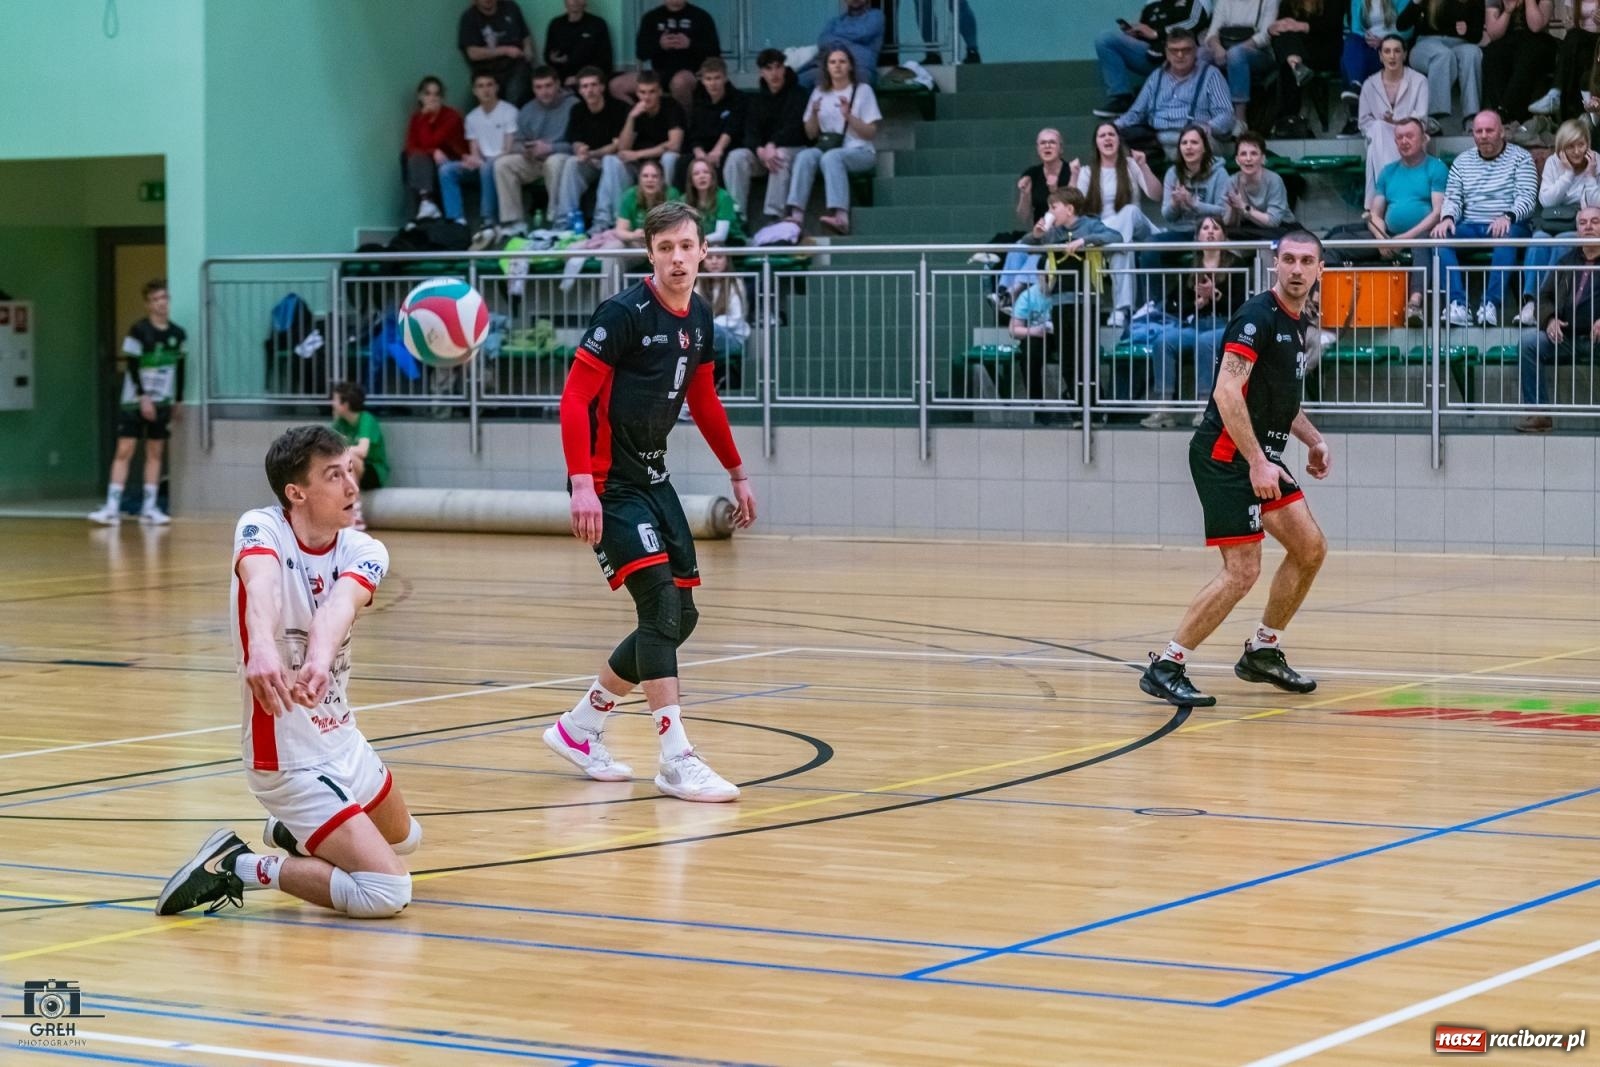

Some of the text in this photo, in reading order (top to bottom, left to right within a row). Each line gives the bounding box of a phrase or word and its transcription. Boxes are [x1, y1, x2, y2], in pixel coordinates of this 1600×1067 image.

[673, 356, 688, 390] 6
[637, 522, 660, 553] 6
[317, 775, 349, 803] 1
